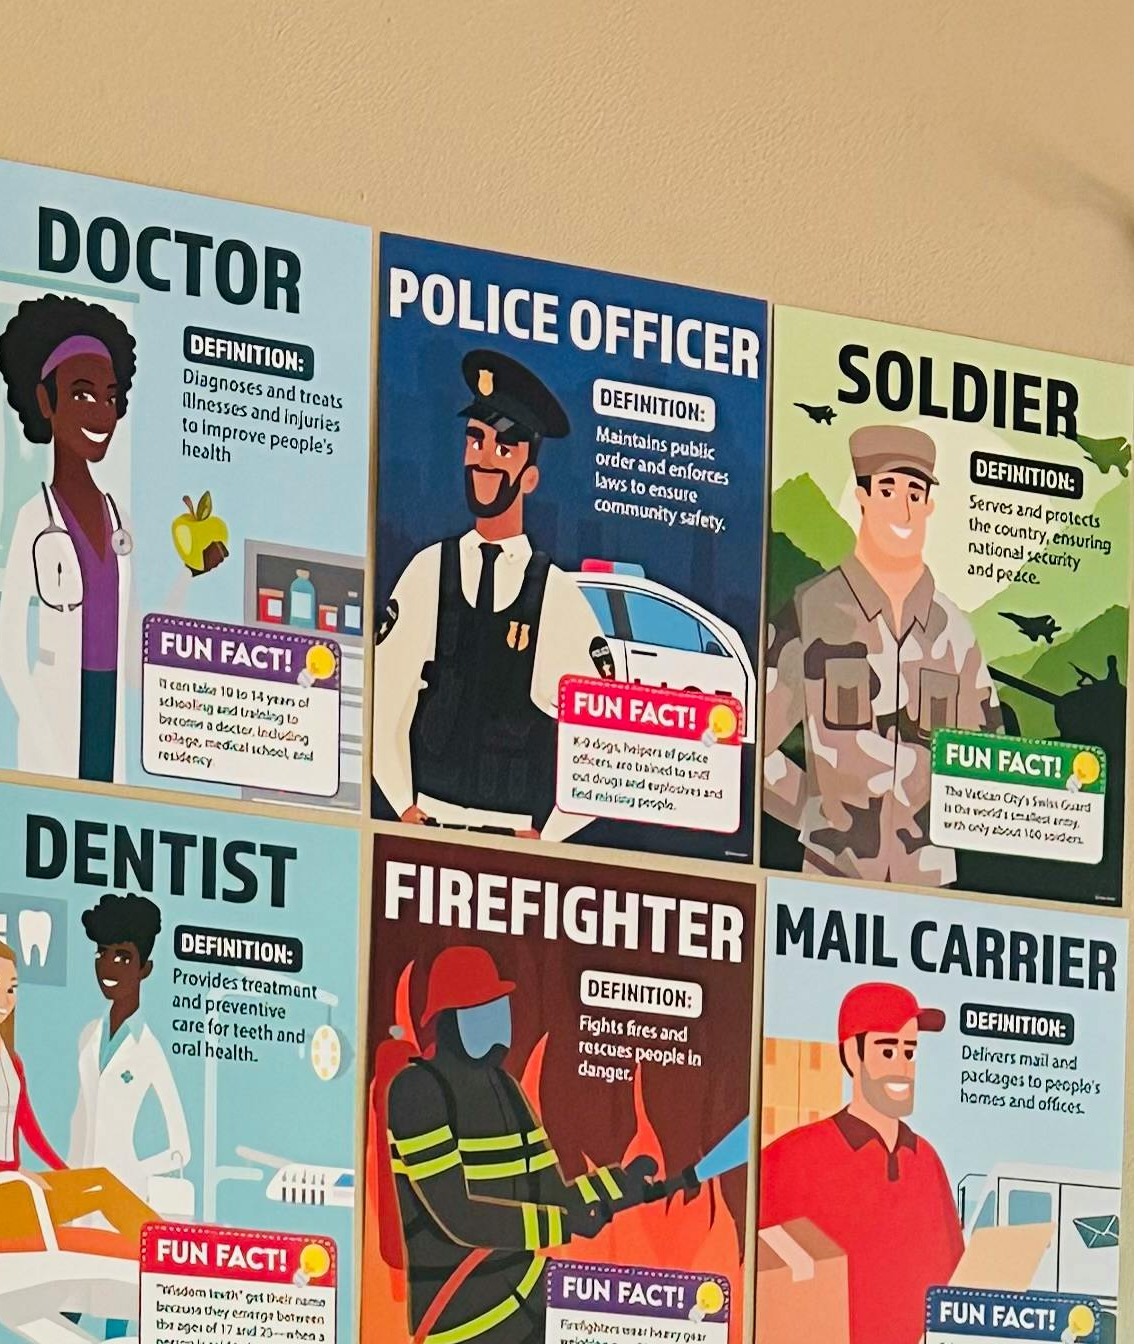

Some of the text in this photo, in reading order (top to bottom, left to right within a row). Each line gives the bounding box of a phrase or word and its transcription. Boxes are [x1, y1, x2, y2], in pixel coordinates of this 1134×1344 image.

[38, 205, 301, 314] DOCTOR
[389, 267, 759, 379] POLICE OFFICER
[190, 335, 303, 372] DEFINITION:
[183, 368, 342, 409] Diagnoses and treats
[600, 387, 704, 422] DEFINITION:
[837, 344, 1079, 440] SOLDIER
[182, 417, 333, 455] to improve people's
[182, 438, 230, 462] health
[595, 451, 728, 485] order and enforces
[976, 458, 1074, 491] DEFINITION:
[595, 471, 697, 503] laws to ensure
[969, 516, 1111, 555] the country, ensuring
[967, 563, 1040, 584] and peace.
[161, 631, 291, 672] FUN FACT!
[574, 691, 696, 730] FUN FACT!
[946, 742, 1061, 778] FUN FACT!
[25, 813, 297, 908] DENTIST
[384, 860, 743, 963] FIREFIGHTER
[181, 932, 293, 965] DEFINITION:
[775, 903, 1116, 992] MAIL CARRIER
[172, 993, 285, 1019] and preventive
[588, 979, 691, 1008] DEFINITION:
[172, 1017, 305, 1043] care for teeth and
[579, 1014, 687, 1042] Fights fires and
[965, 1009, 1066, 1038] DEFINITION:
[171, 1040, 258, 1062] oral health.
[961, 1044, 1077, 1070] Delivers mail and
[578, 1060, 633, 1082] danger.
[960, 1087, 1005, 1107] homes
[1009, 1094, 1034, 1109] and
[157, 1238, 286, 1272] FUN FACT!
[562, 1275, 684, 1309] FUN FACT!
[940, 1300, 1055, 1331] FUN FACT!
